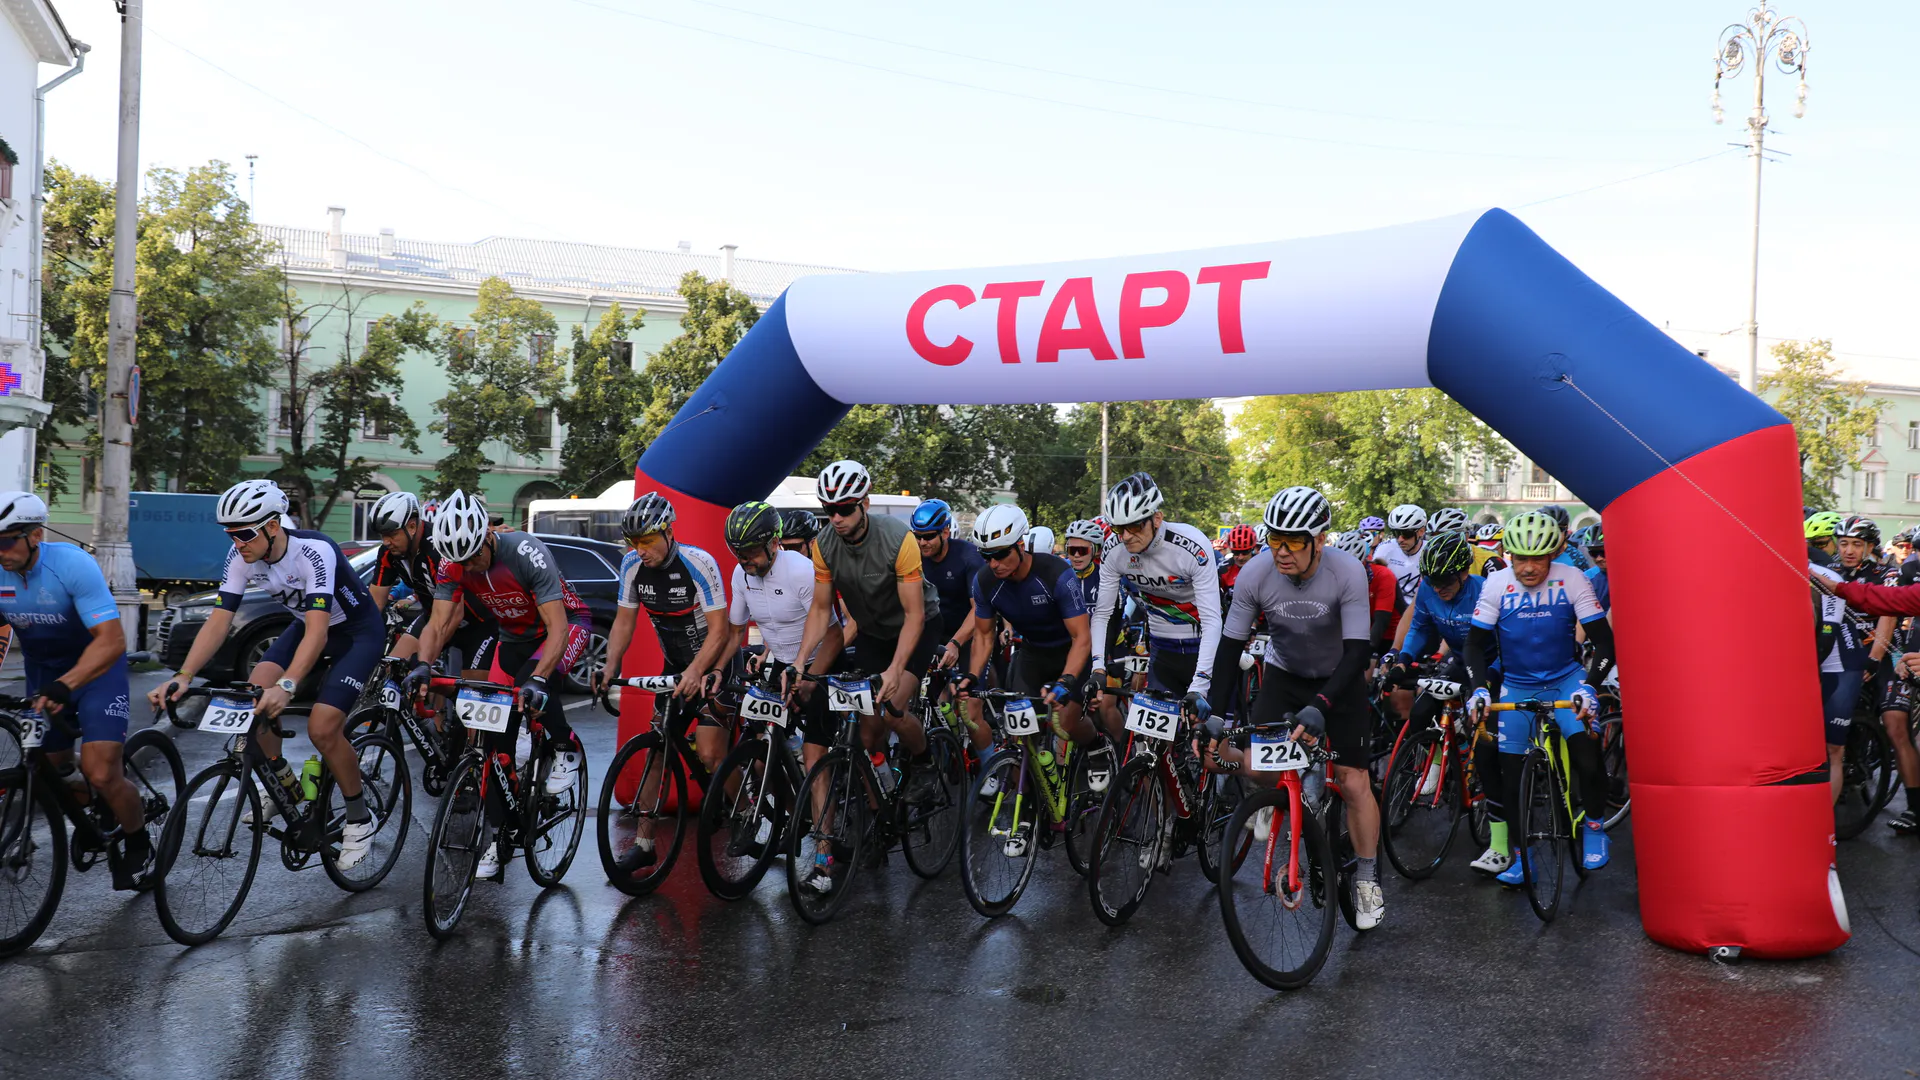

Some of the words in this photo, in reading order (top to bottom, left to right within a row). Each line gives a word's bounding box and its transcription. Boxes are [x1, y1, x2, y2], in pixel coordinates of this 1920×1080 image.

[906, 261, 1271, 366] СТАРТ
[1172, 534, 1198, 556] PDM
[302, 545, 327, 588] ЧЕЛЯБИНСК
[638, 584, 656, 595] RAIL
[1125, 573, 1166, 587] PDM
[1501, 587, 1570, 608] ITALIA
[564, 629, 588, 665] Silence
[1424, 679, 1454, 695] 226
[210, 710, 249, 728] 289
[461, 702, 502, 724] 260
[748, 700, 782, 718] 400
[1137, 709, 1170, 733] 152
[1260, 742, 1302, 764] 224
